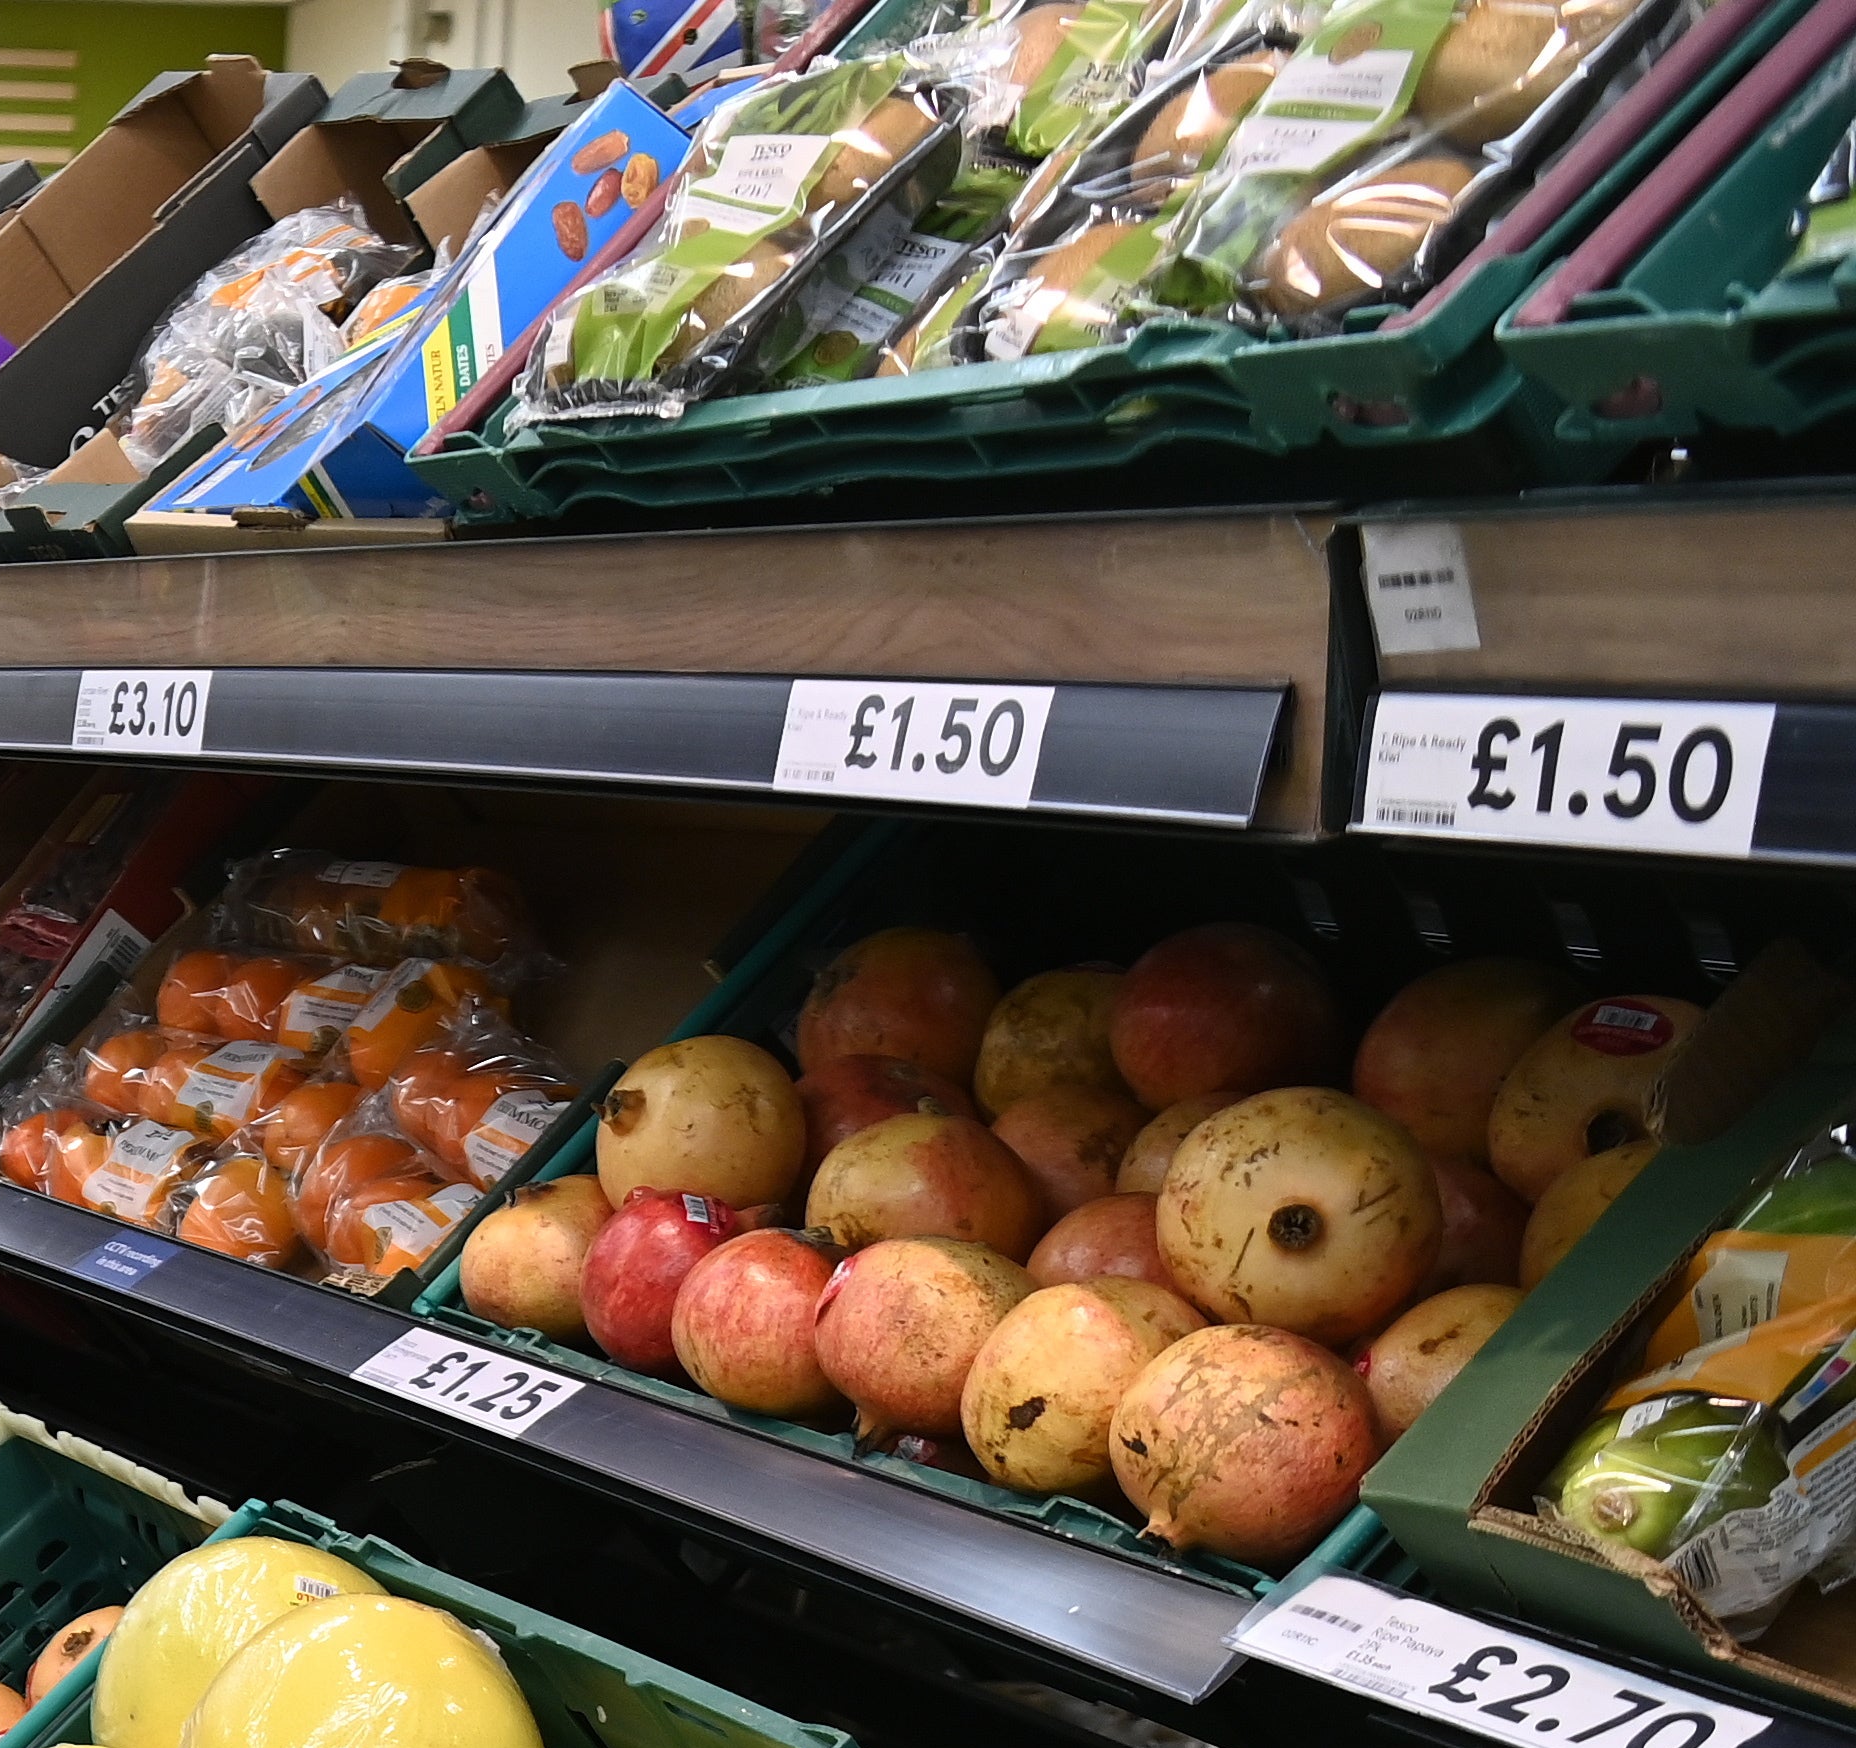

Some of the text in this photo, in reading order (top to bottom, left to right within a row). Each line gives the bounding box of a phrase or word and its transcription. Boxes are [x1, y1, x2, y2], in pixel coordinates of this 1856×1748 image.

[458, 343, 471, 388] DATES
[90, 372, 138, 417] TES
[108, 680, 197, 738] £3.10
[843, 694, 1026, 777] £1.50
[1391, 733, 1417, 751] Ripe
[1420, 736, 1428, 747] &
[1430, 735, 1467, 753] Ready
[1377, 749, 1401, 763] Kiwi
[1467, 716, 1734, 825] £1.50
[104, 1240, 163, 1269] CCTV recording
[408, 1350, 563, 1421] £1.25
[1371, 1627, 1445, 1659] Ripe Papaya
[1385, 1614, 1420, 1635] Tesco
[1344, 1649, 1374, 1666] £1.35
